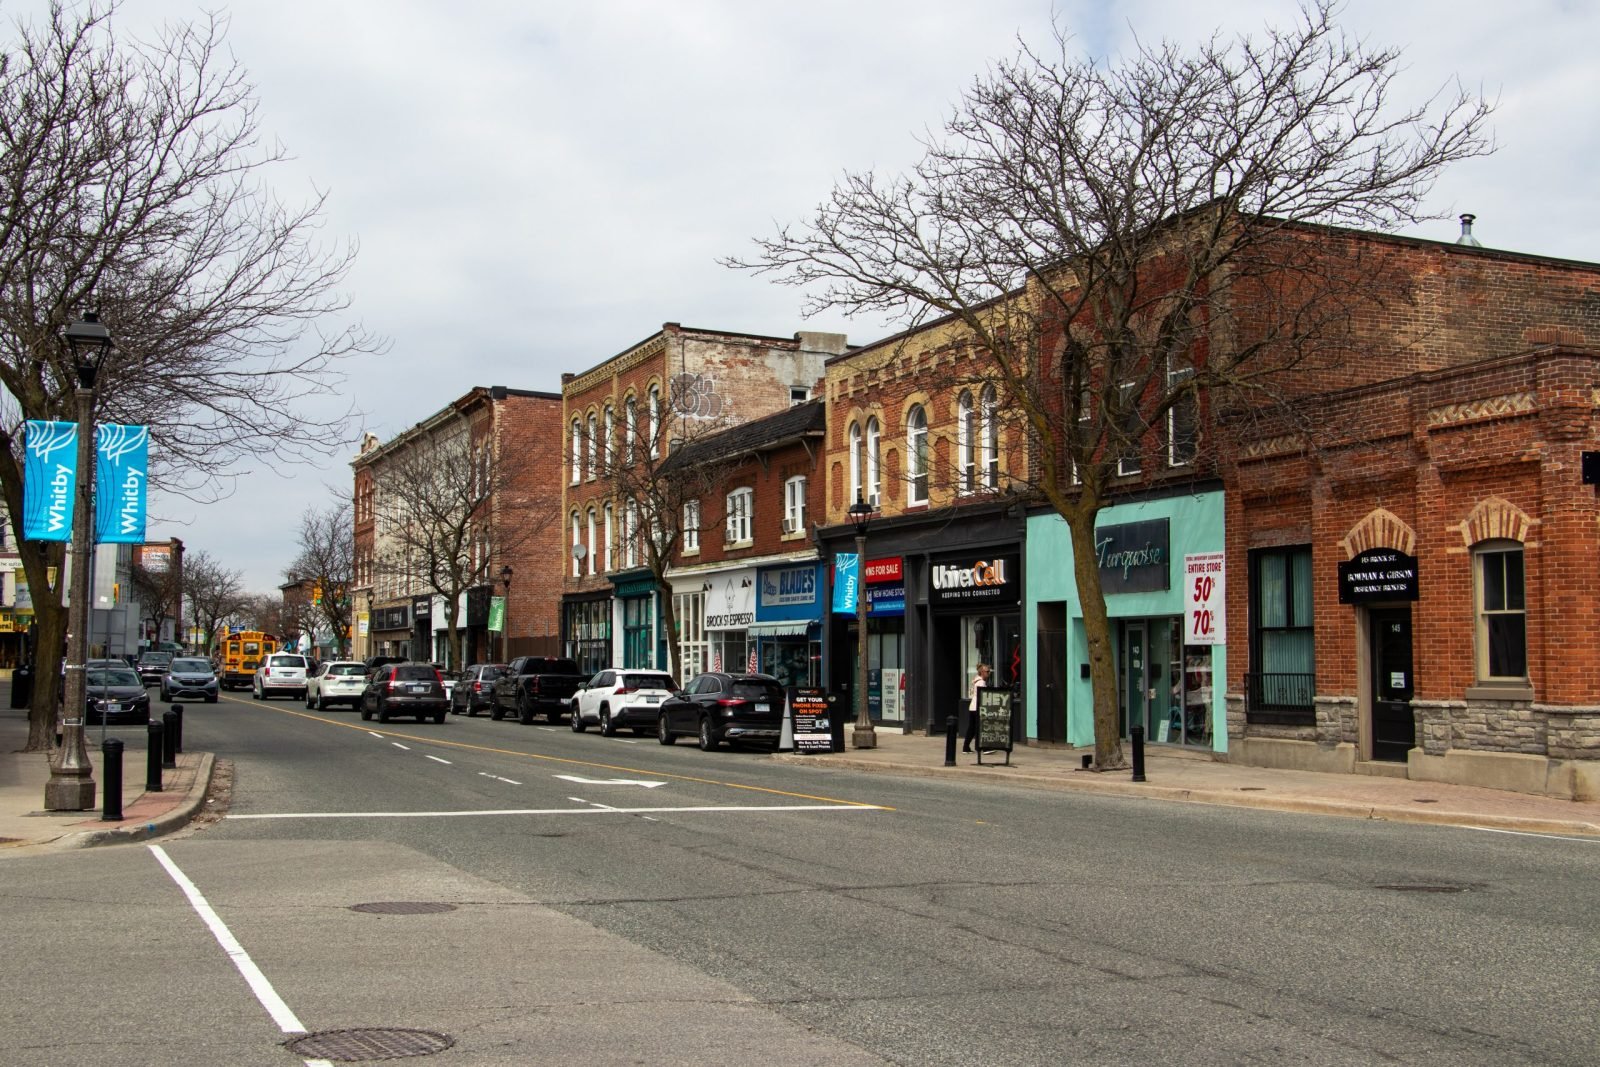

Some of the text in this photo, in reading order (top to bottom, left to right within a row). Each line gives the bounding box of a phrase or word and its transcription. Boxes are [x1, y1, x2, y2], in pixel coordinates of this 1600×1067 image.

[48, 464, 73, 532] Whitby
[121, 466, 144, 534] Whitby
[1096, 537, 1160, 580] Turquoise
[1188, 562, 1221, 573] ENTIRE STORE
[876, 565, 885, 575] FOR
[886, 564, 899, 574] SALE
[932, 559, 1007, 590] UniverCell
[1379, 571, 1384, 579] &
[780, 568, 815, 595] BLADES
[844, 575, 856, 609] Whitby
[942, 591, 960, 599] KEEPING
[706, 616, 724, 627] BROCK
[729, 612, 754, 625] ESPRESSO
[982, 692, 1009, 706] HEY
